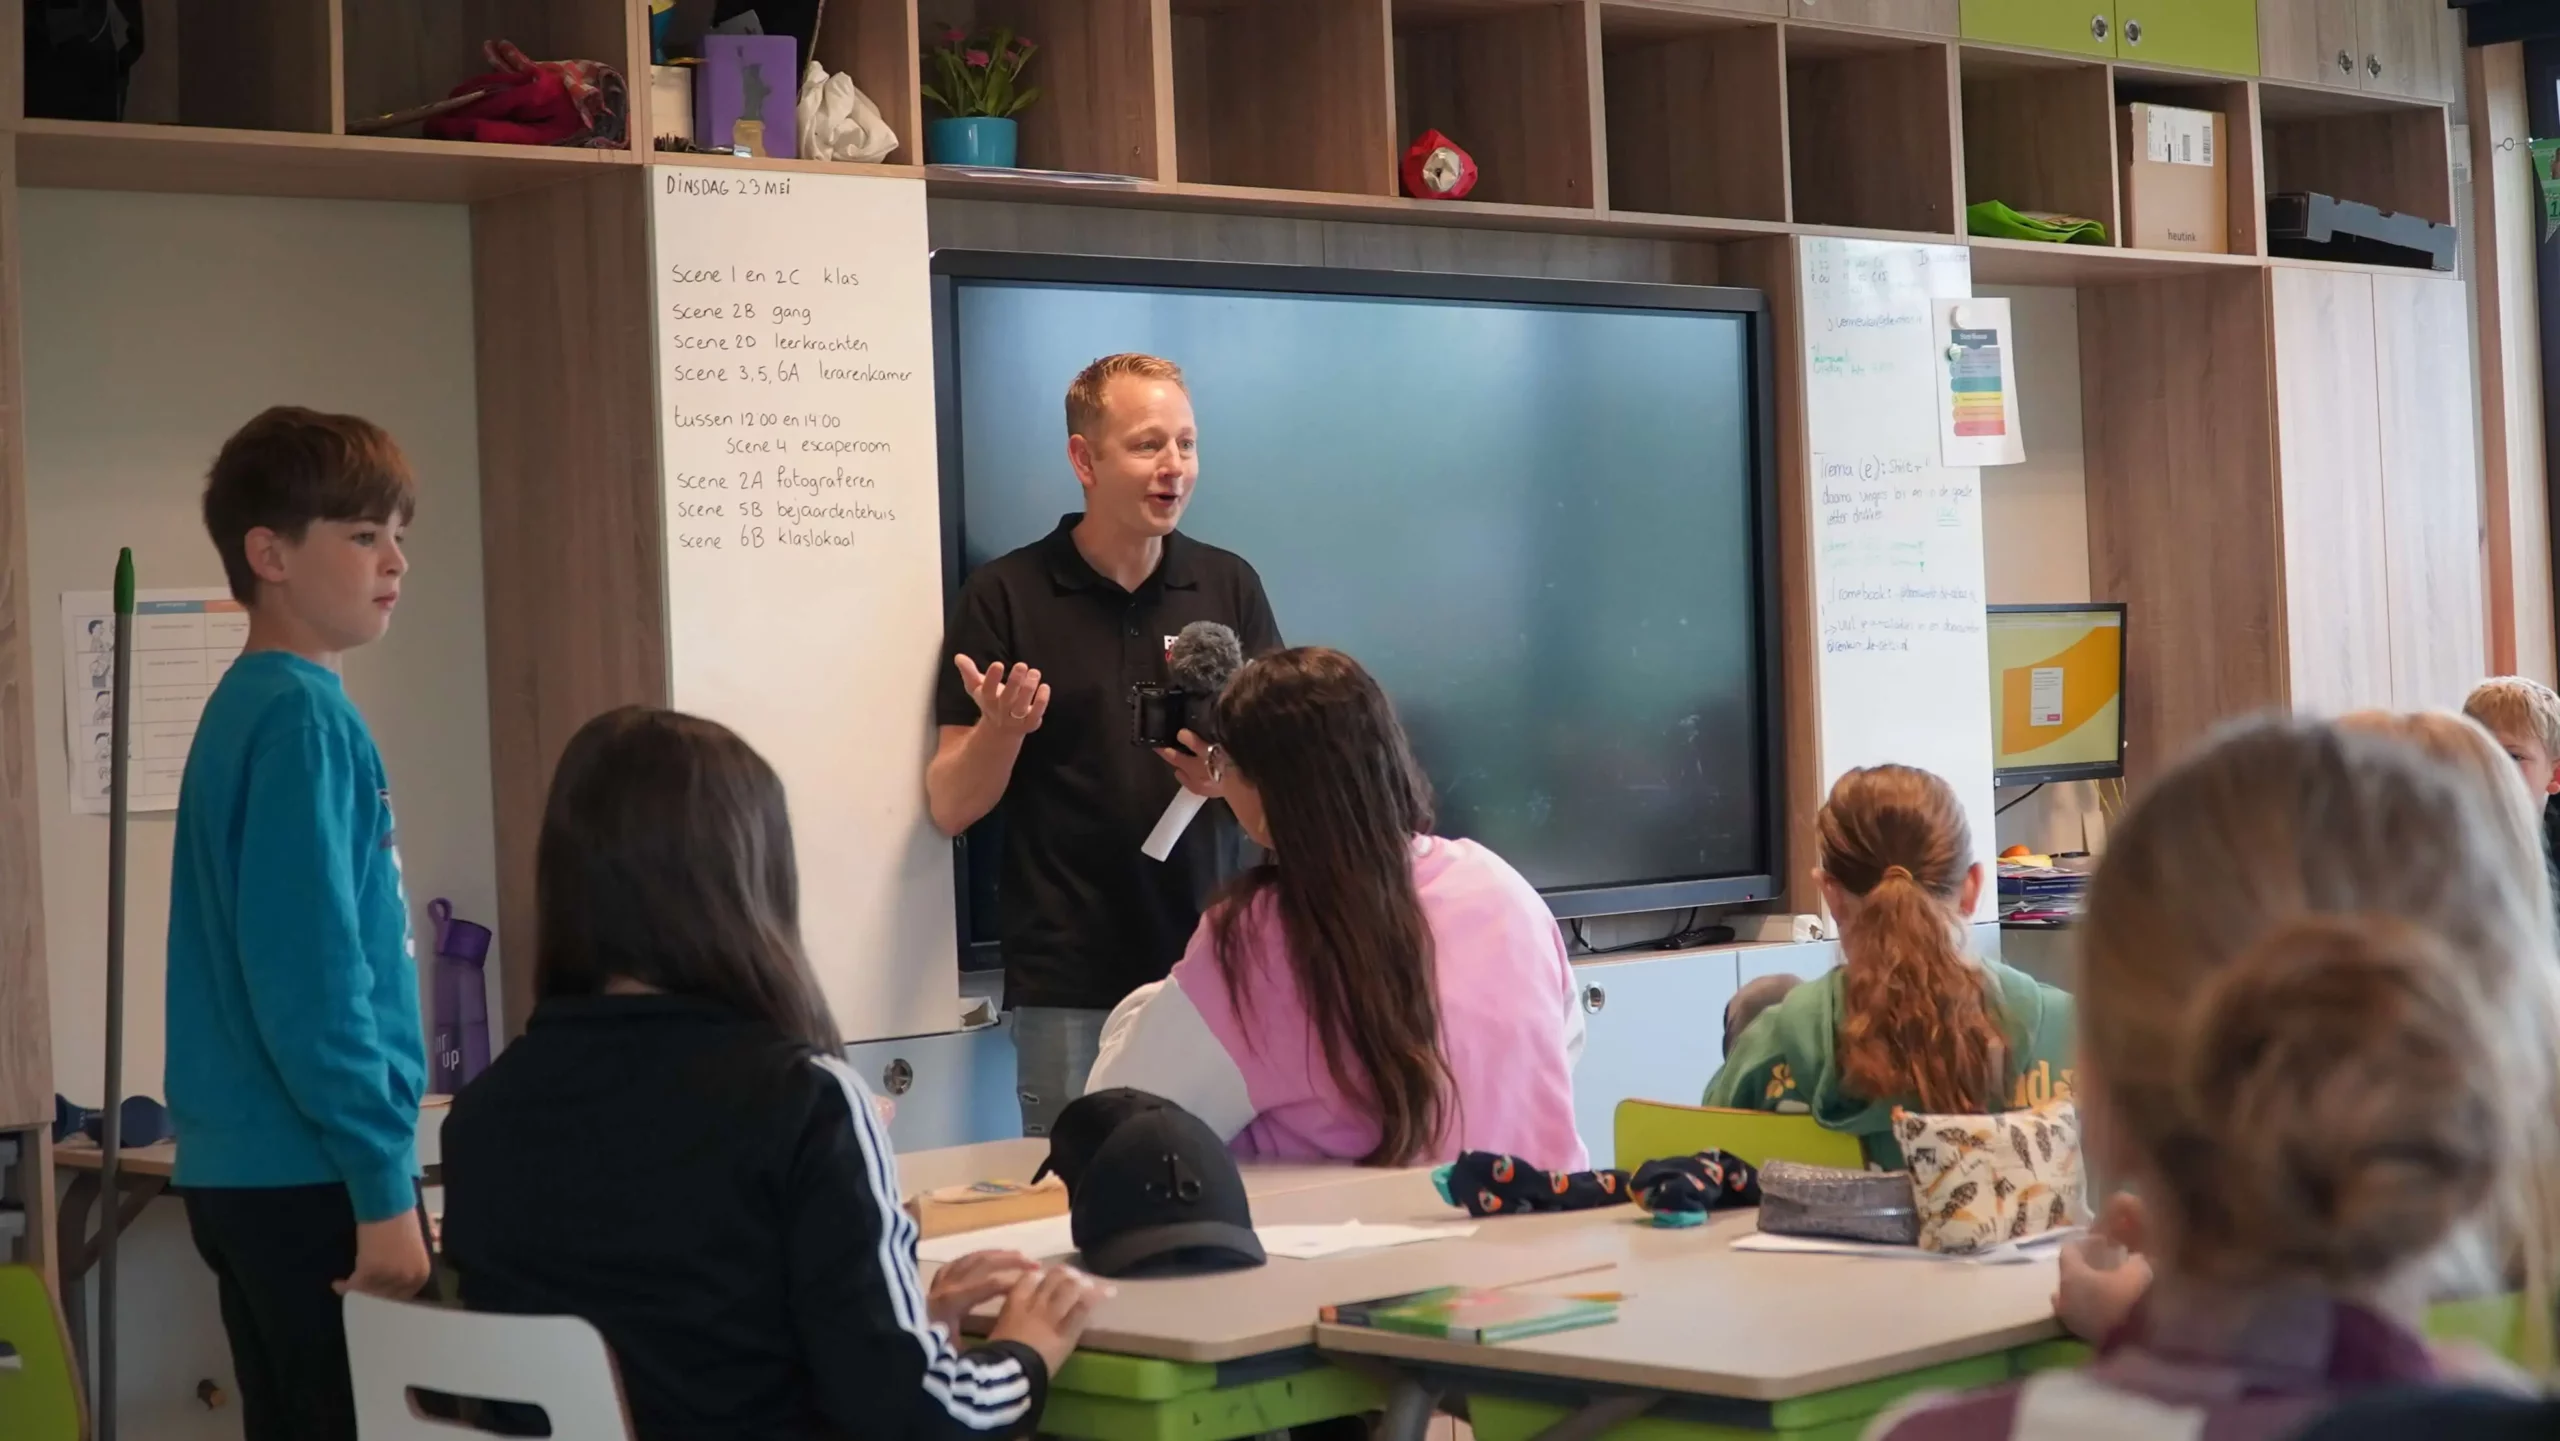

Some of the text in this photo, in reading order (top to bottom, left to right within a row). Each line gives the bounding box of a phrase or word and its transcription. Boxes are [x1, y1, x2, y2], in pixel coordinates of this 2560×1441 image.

[735, 178, 761, 196] 23
[2167, 228, 2197, 242] heutink
[671, 263, 723, 284] Scene
[745, 269, 766, 283] en
[775, 268, 800, 286] 2C
[823, 267, 860, 287] klas
[672, 302, 812, 326] Scene 2B gang
[673, 332, 869, 352] Scene 2D leerkrachten
[674, 364, 729, 382] Scene
[818, 359, 913, 382] lerarenkamer
[674, 404, 733, 428] tussen
[782, 414, 800, 427] en
[725, 436, 891, 455] Scene 4 escaperoom
[676, 464, 875, 497] Scene 2A fotograferen
[677, 500, 896, 526] Scene 5B bejaardentehuis
[740, 523, 765, 549] 6B
[778, 527, 855, 548] klaslokaal
[442, 1049, 460, 1072] up
